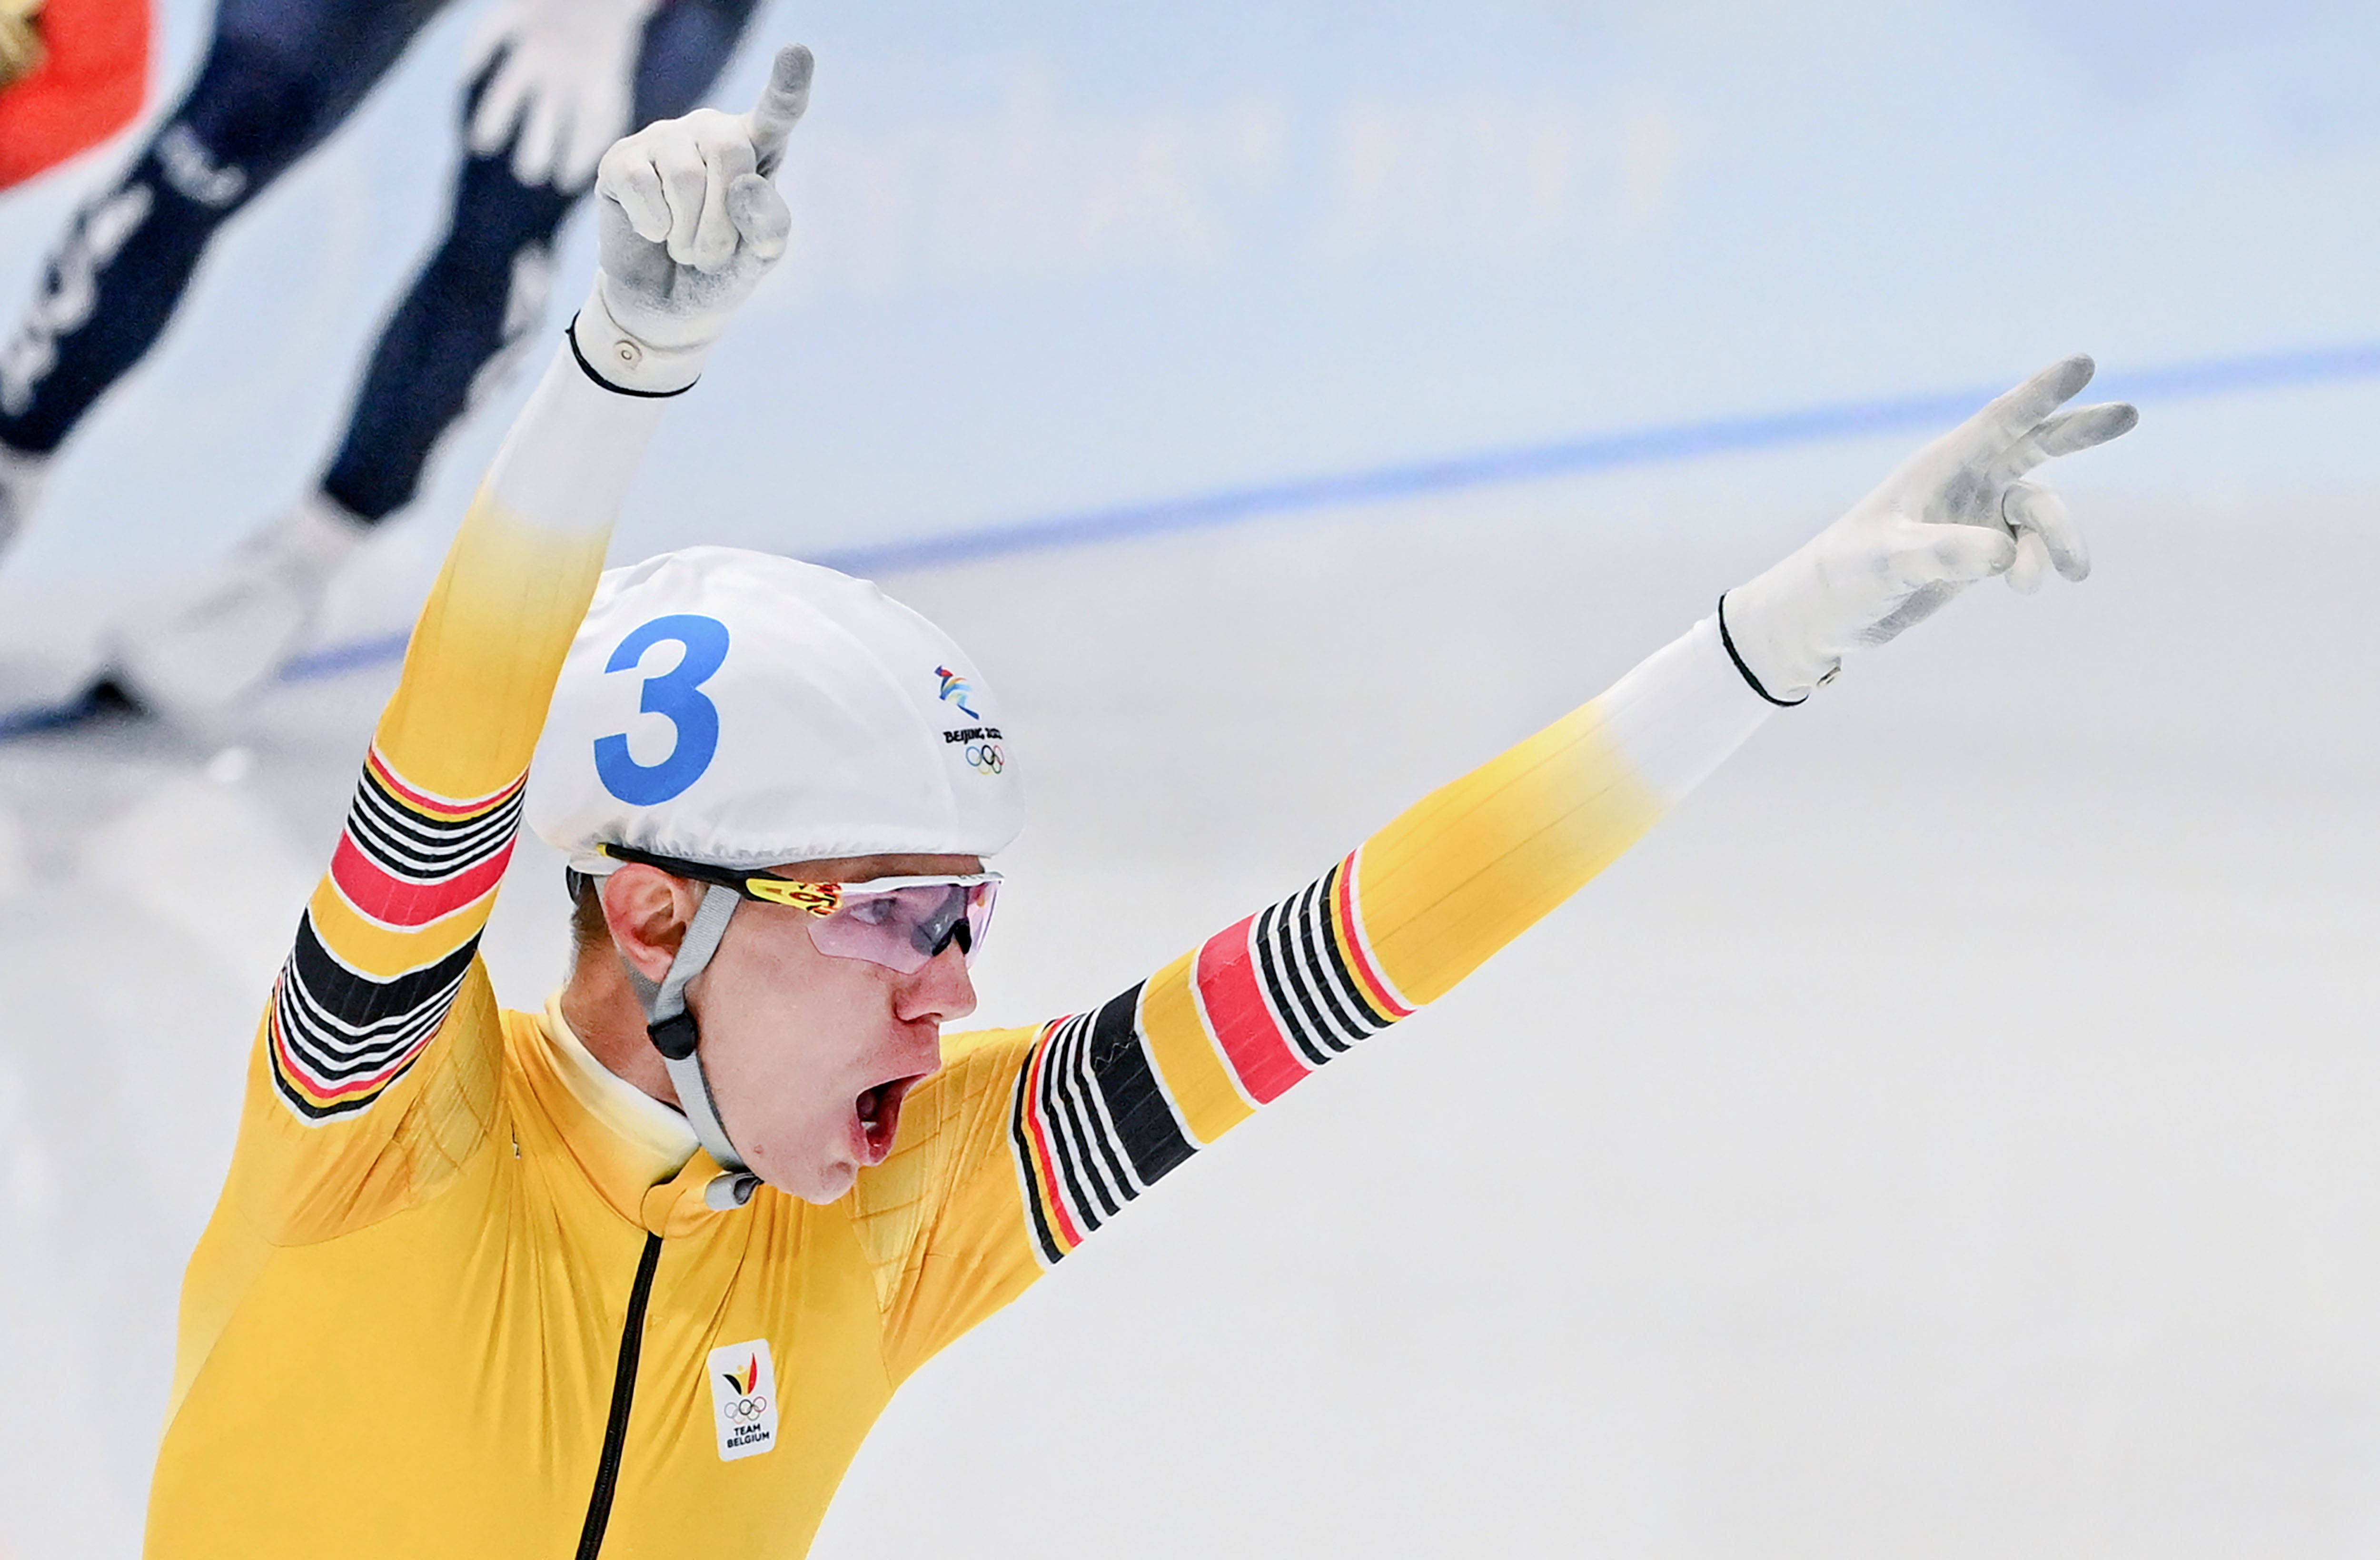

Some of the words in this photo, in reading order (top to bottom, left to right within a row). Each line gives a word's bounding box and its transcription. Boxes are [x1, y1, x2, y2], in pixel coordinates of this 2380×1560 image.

[594, 613, 730, 806] 3
[943, 728, 984, 745] BEIJING
[734, 1423, 761, 1436] TEAM
[726, 1431, 770, 1448] BELGIUM
